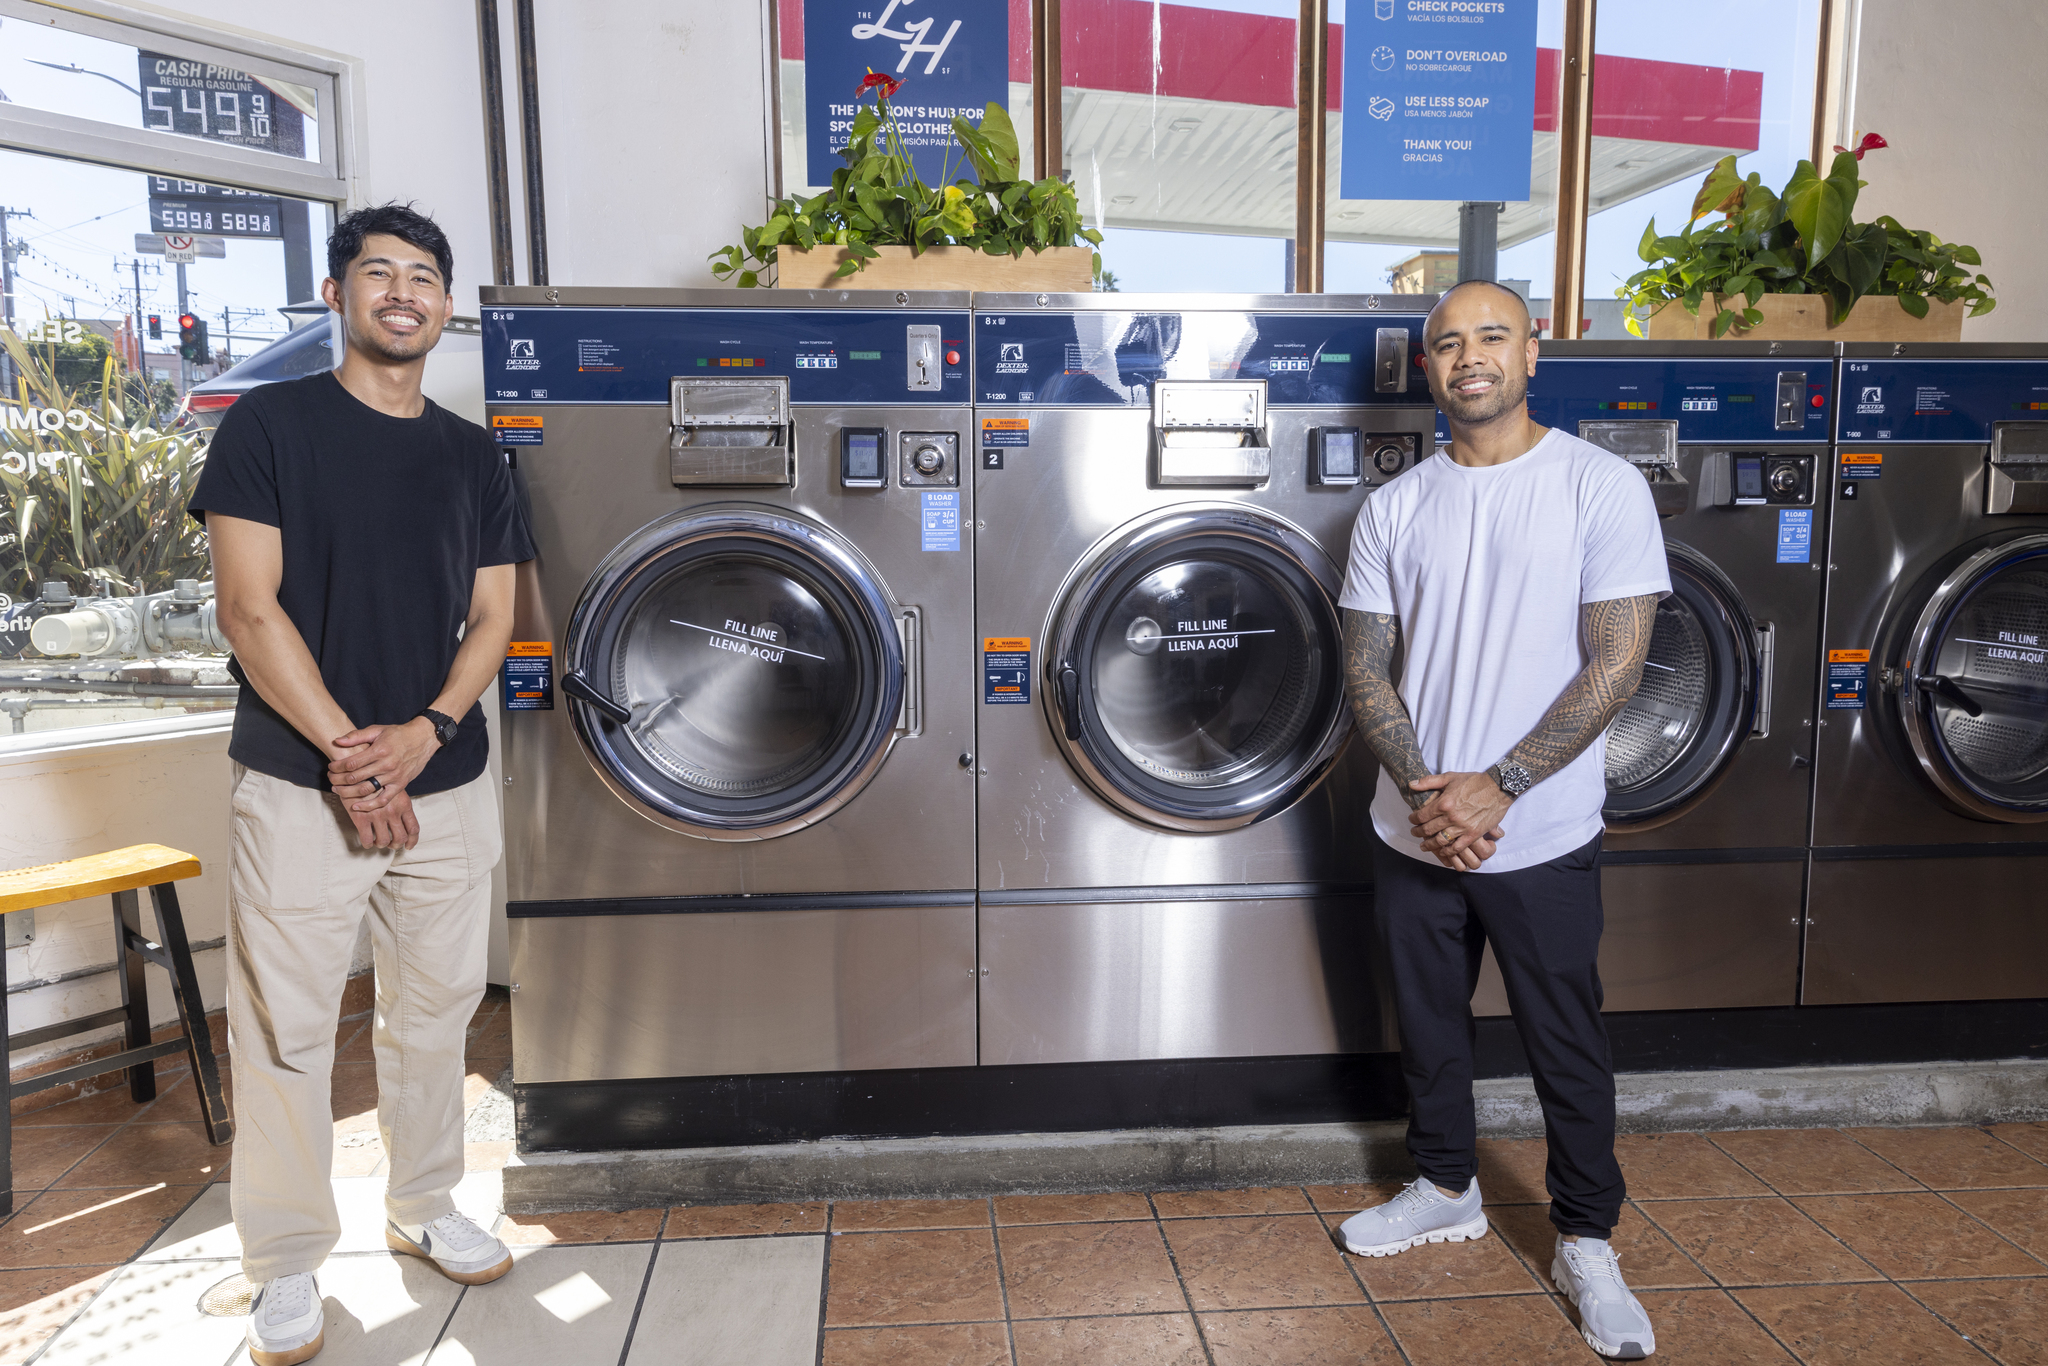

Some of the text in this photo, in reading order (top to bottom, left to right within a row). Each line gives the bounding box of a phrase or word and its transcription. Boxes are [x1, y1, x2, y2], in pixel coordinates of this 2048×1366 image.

[1408, 1, 1505, 13] CHECK POCKETS
[1407, 13, 1430, 22] VACÍA
[1448, 16, 1484, 24] BOLSILLOS
[1406, 50, 1508, 62] DON'T OVERLOAD
[155, 60, 201, 78] CASH
[1418, 64, 1472, 72] SOBRECARGUE
[160, 77, 253, 92] REGULAR GASOLINE
[1404, 96, 1426, 107] USE
[1429, 97, 1455, 107] LESS
[1458, 97, 1489, 108] SOAP
[829, 104, 984, 119] THE MSION'S HUB FOR
[1448, 109, 1473, 118] JABÓN
[898, 122, 955, 135] CLOTHES
[900, 136, 928, 145] MISIÓN
[1404, 140, 1472, 150] THANK YOU!
[1402, 154, 1443, 162] GRACIAS
[492, 312, 498, 320] 8
[989, 454, 998, 464] 2
[1845, 486, 1853, 496] 4
[724, 619, 778, 642] FILL LINE
[1178, 619, 1227, 632] FILL LINE
[1168, 635, 1238, 652] LLENA AQUÍ
[1999, 631, 2038, 645] FILL LINE
[709, 636, 785, 663] LLENA AQUÍ
[1988, 648, 2044, 663] LLENA AQUÍ
